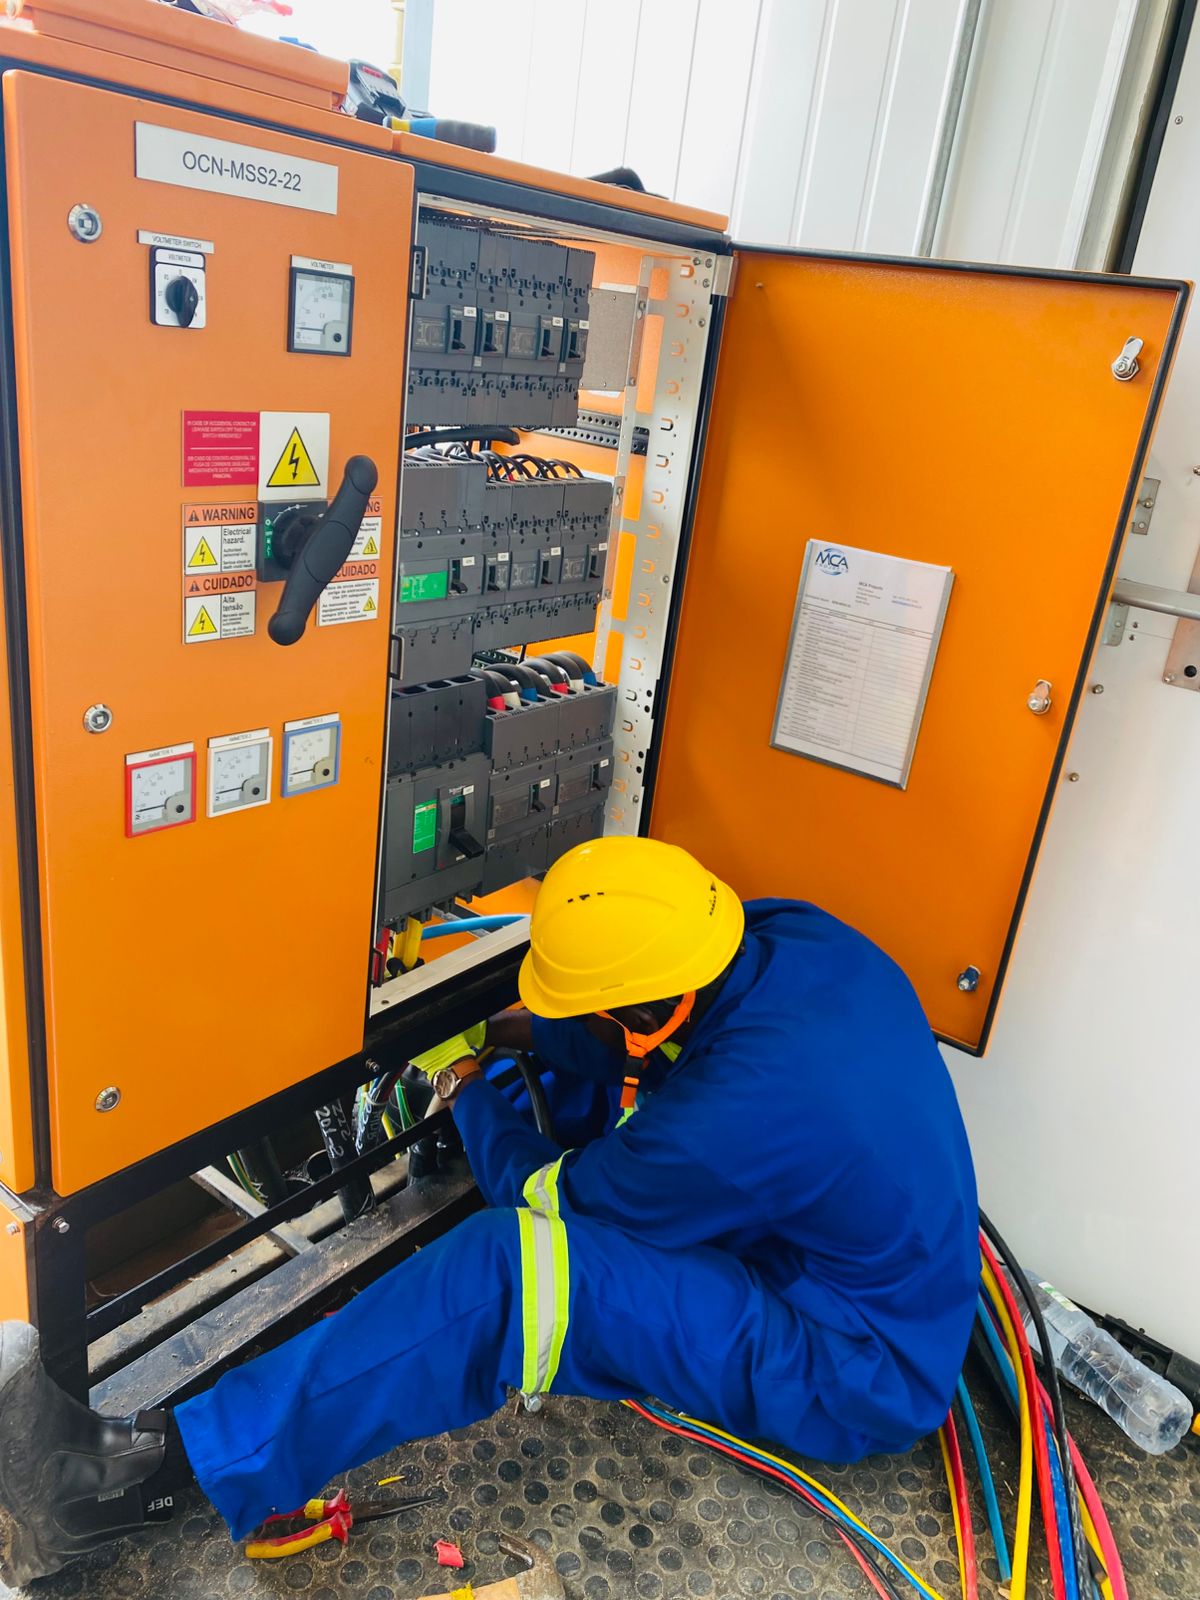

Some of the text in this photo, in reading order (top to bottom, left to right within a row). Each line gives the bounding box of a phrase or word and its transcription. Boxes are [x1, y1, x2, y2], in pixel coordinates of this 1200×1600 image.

[182, 150, 302, 192] OCN-MSS2-22
[152, 235, 202, 249] VOLTMETER SWITCH
[311, 261, 334, 270] VOLTMETER
[202, 507, 255, 521] WARNING
[223, 528, 251, 536] Electrical
[816, 551, 849, 569] MCA
[203, 575, 253, 591] CUIDADO
[147, 1496, 173, 1513] DEF
